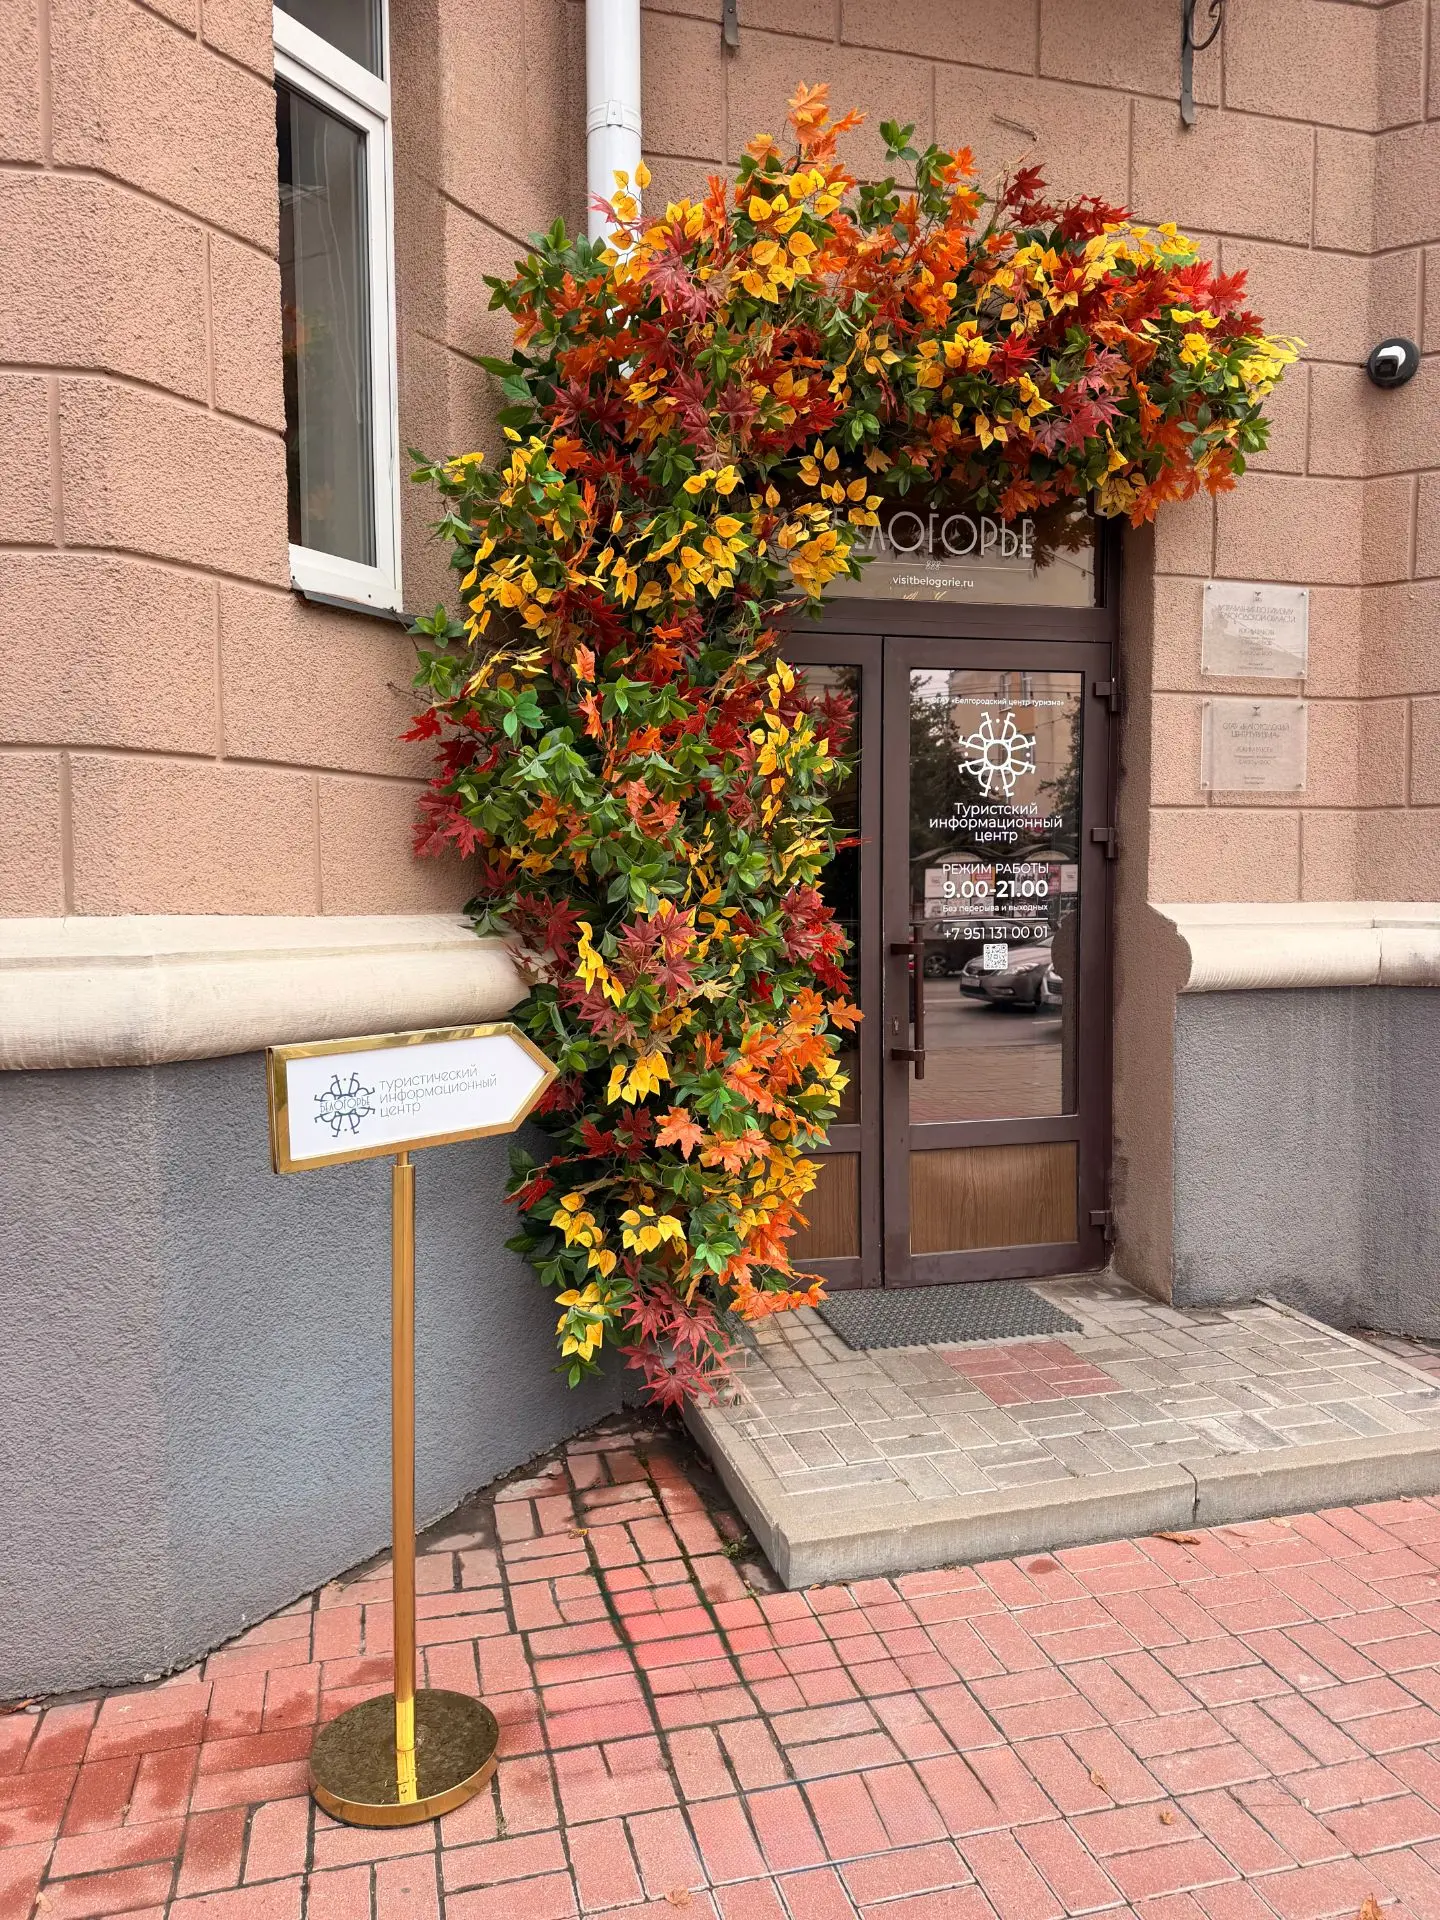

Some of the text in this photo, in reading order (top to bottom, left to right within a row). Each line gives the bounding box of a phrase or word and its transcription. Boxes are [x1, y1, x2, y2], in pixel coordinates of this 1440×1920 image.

[833, 502, 1033, 558] ЛОГОРЬЕ
[892, 575, 974, 588] visitbelogorie.ru
[954, 802, 1038, 817] Туристский
[929, 816, 1063, 830] информационный
[975, 832, 1018, 843] центр
[942, 862, 1049, 875] РЕЖИМ РАБОТЫ
[943, 880, 1049, 899] 9.00-21.00
[1008, 904, 1048, 912] выходных
[943, 925, 1049, 940] +7 951 131 00 01
[379, 1064, 479, 1091] туристический
[379, 1073, 497, 1104] информационный
[380, 1102, 421, 1118] центр
